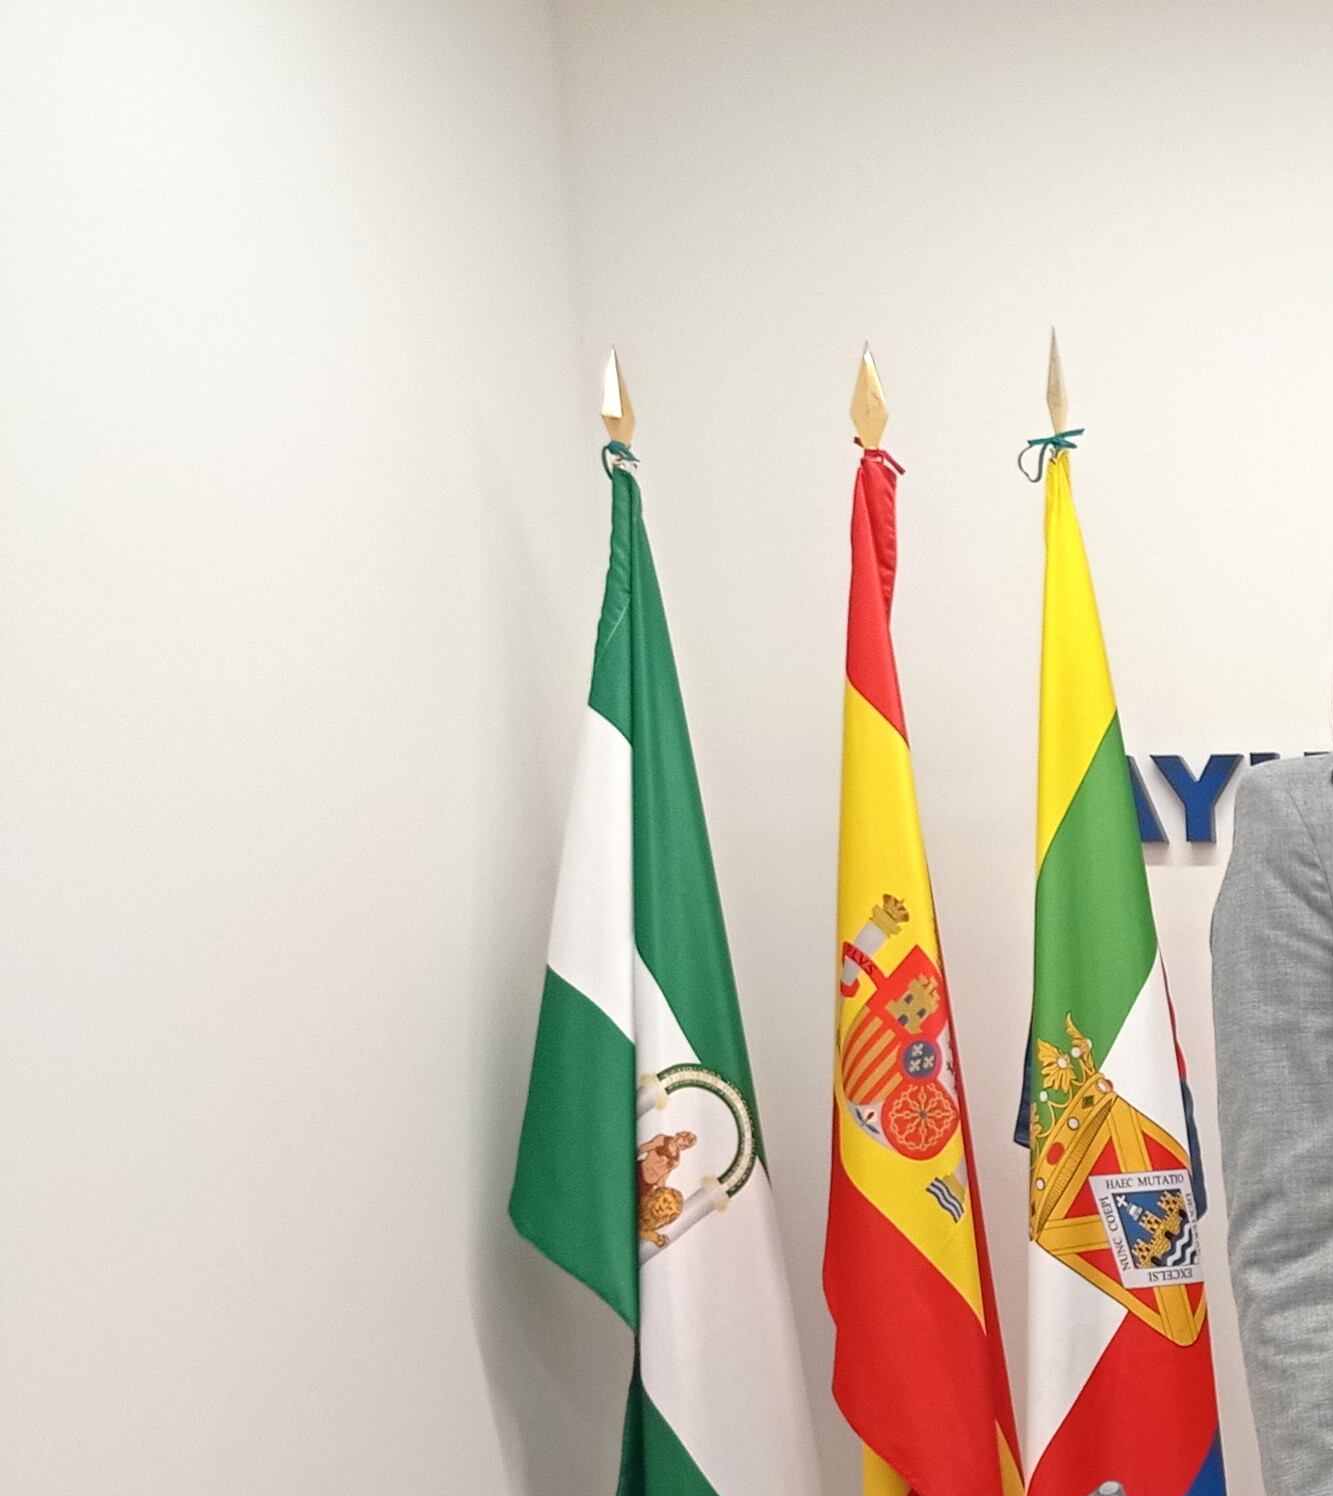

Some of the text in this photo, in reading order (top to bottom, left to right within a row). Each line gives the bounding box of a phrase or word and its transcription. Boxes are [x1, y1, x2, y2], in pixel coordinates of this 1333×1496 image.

[1105, 1178, 1133, 1190] HAEC
[1099, 1196, 1132, 1271] NUNC COEPI
[1148, 1267, 1194, 1282] EXCELSI
